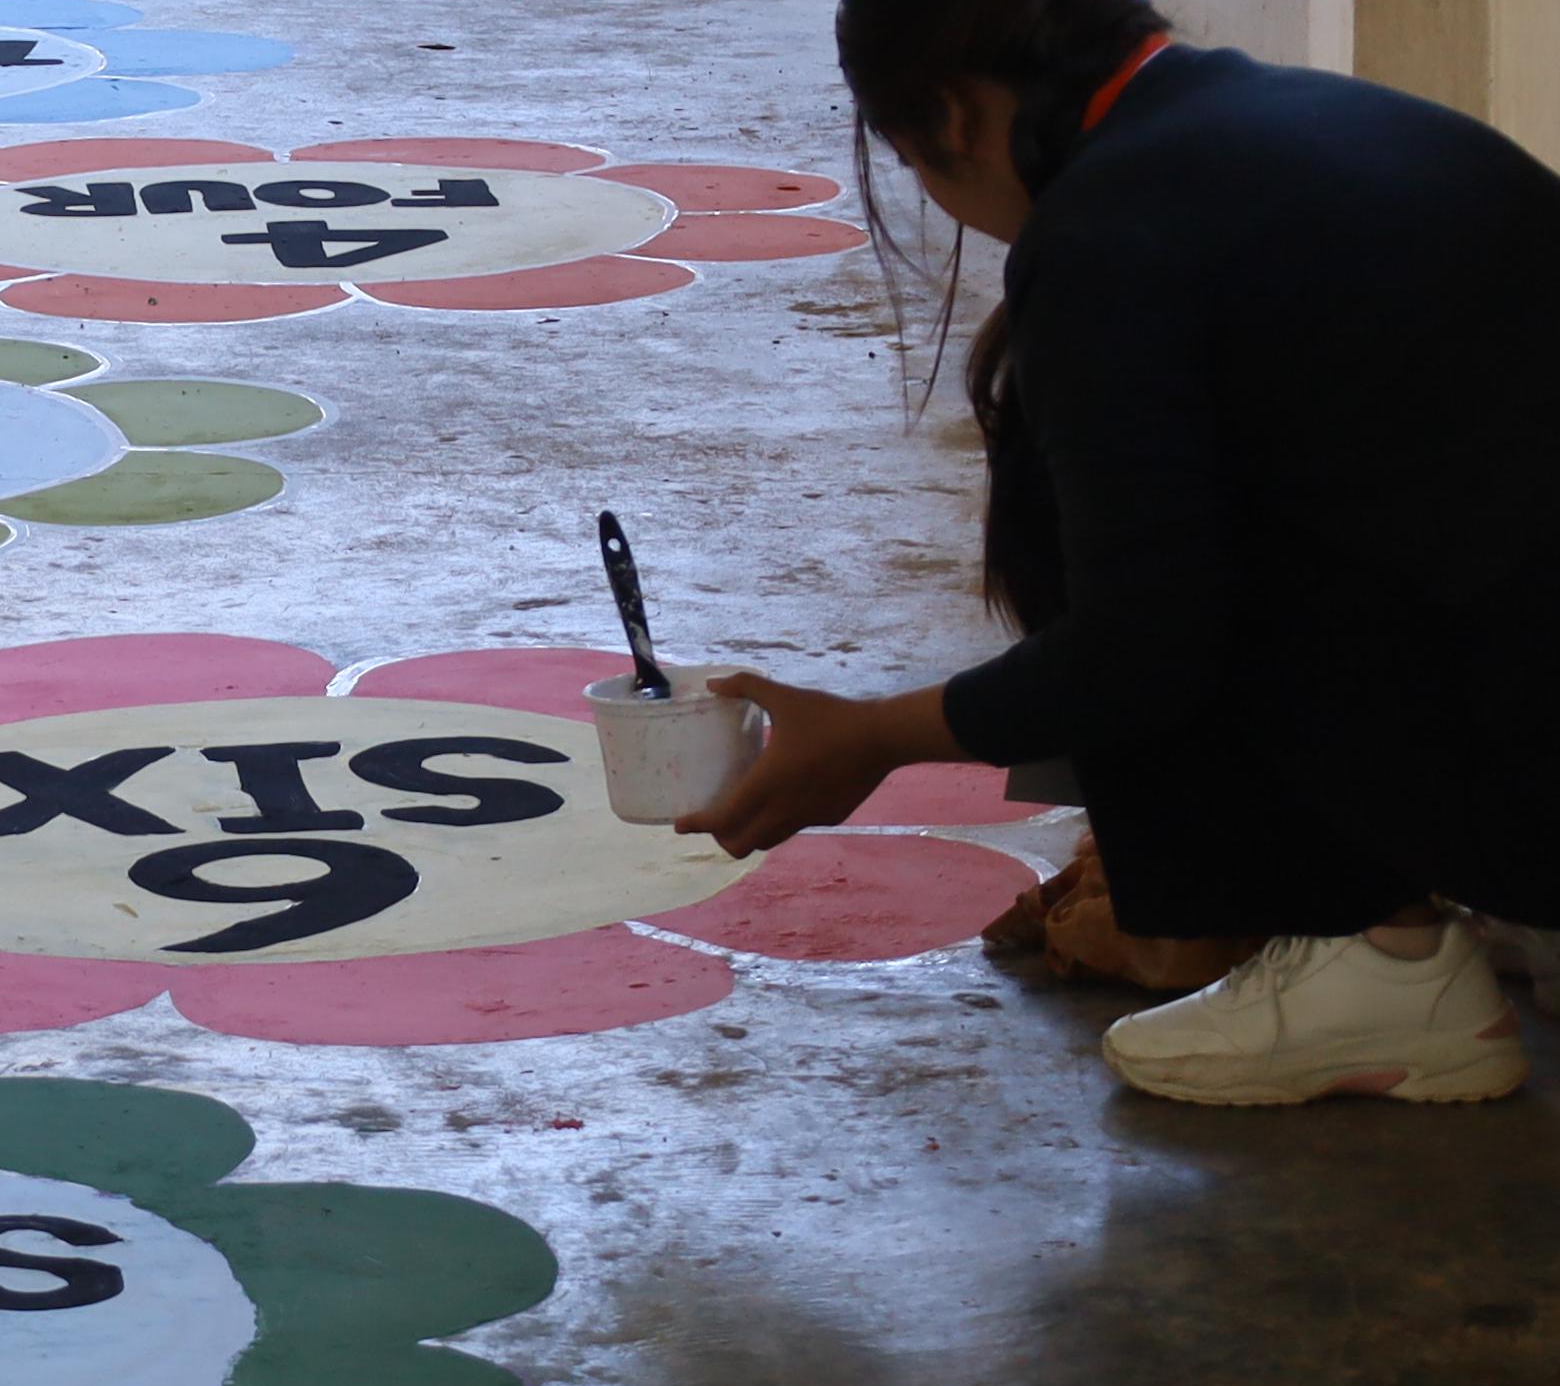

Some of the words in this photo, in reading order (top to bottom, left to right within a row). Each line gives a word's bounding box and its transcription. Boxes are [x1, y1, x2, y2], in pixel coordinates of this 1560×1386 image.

[17, 179, 500, 218] FOUR
[222, 220, 449, 269] 4
[126, 838, 421, 954] 6
